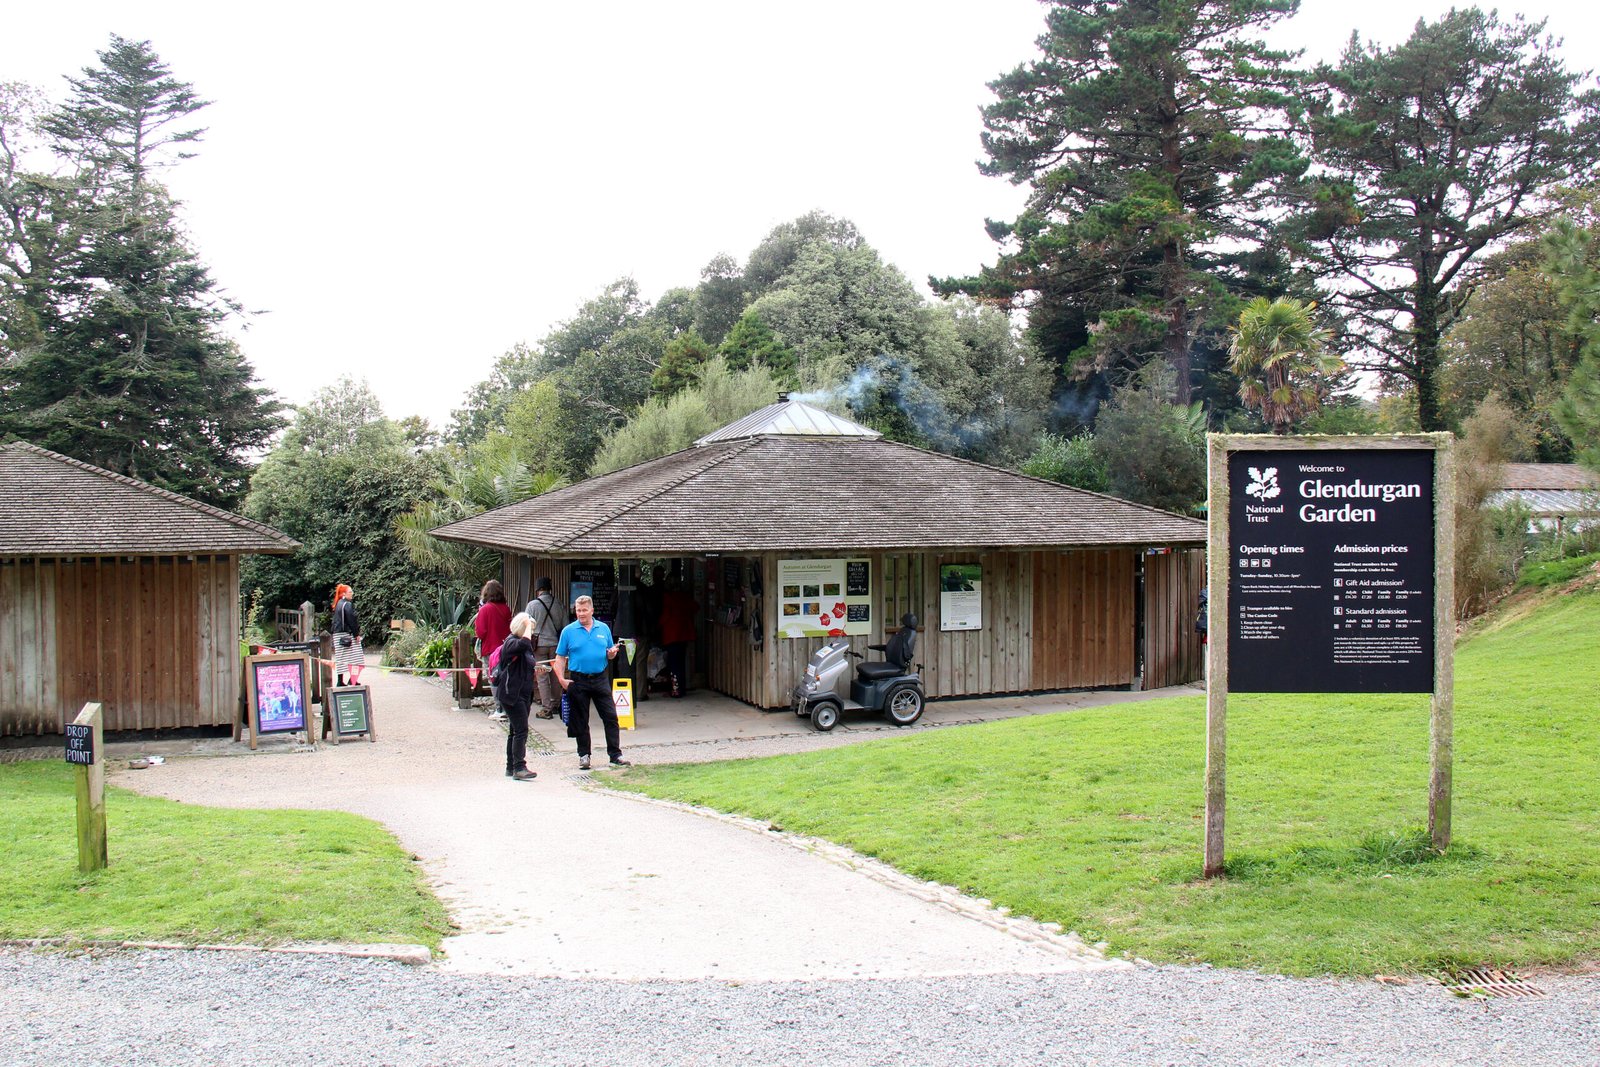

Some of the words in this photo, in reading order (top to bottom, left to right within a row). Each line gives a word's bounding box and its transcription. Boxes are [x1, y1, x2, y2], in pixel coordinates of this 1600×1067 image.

[1298, 465, 1334, 473] Welcome
[1336, 465, 1345, 473] to
[1299, 479, 1421, 502] Glendurgan
[1246, 505, 1284, 514] National
[1299, 504, 1376, 522] Garden
[1245, 514, 1269, 523] Trust
[1240, 544, 1278, 555] Opening
[1280, 544, 1304, 553] times
[1334, 544, 1380, 553] Admission
[1381, 544, 1408, 554] prices
[67, 726, 88, 738] DROP
[70, 738, 84, 750] OFF
[67, 749, 91, 763] POINT
